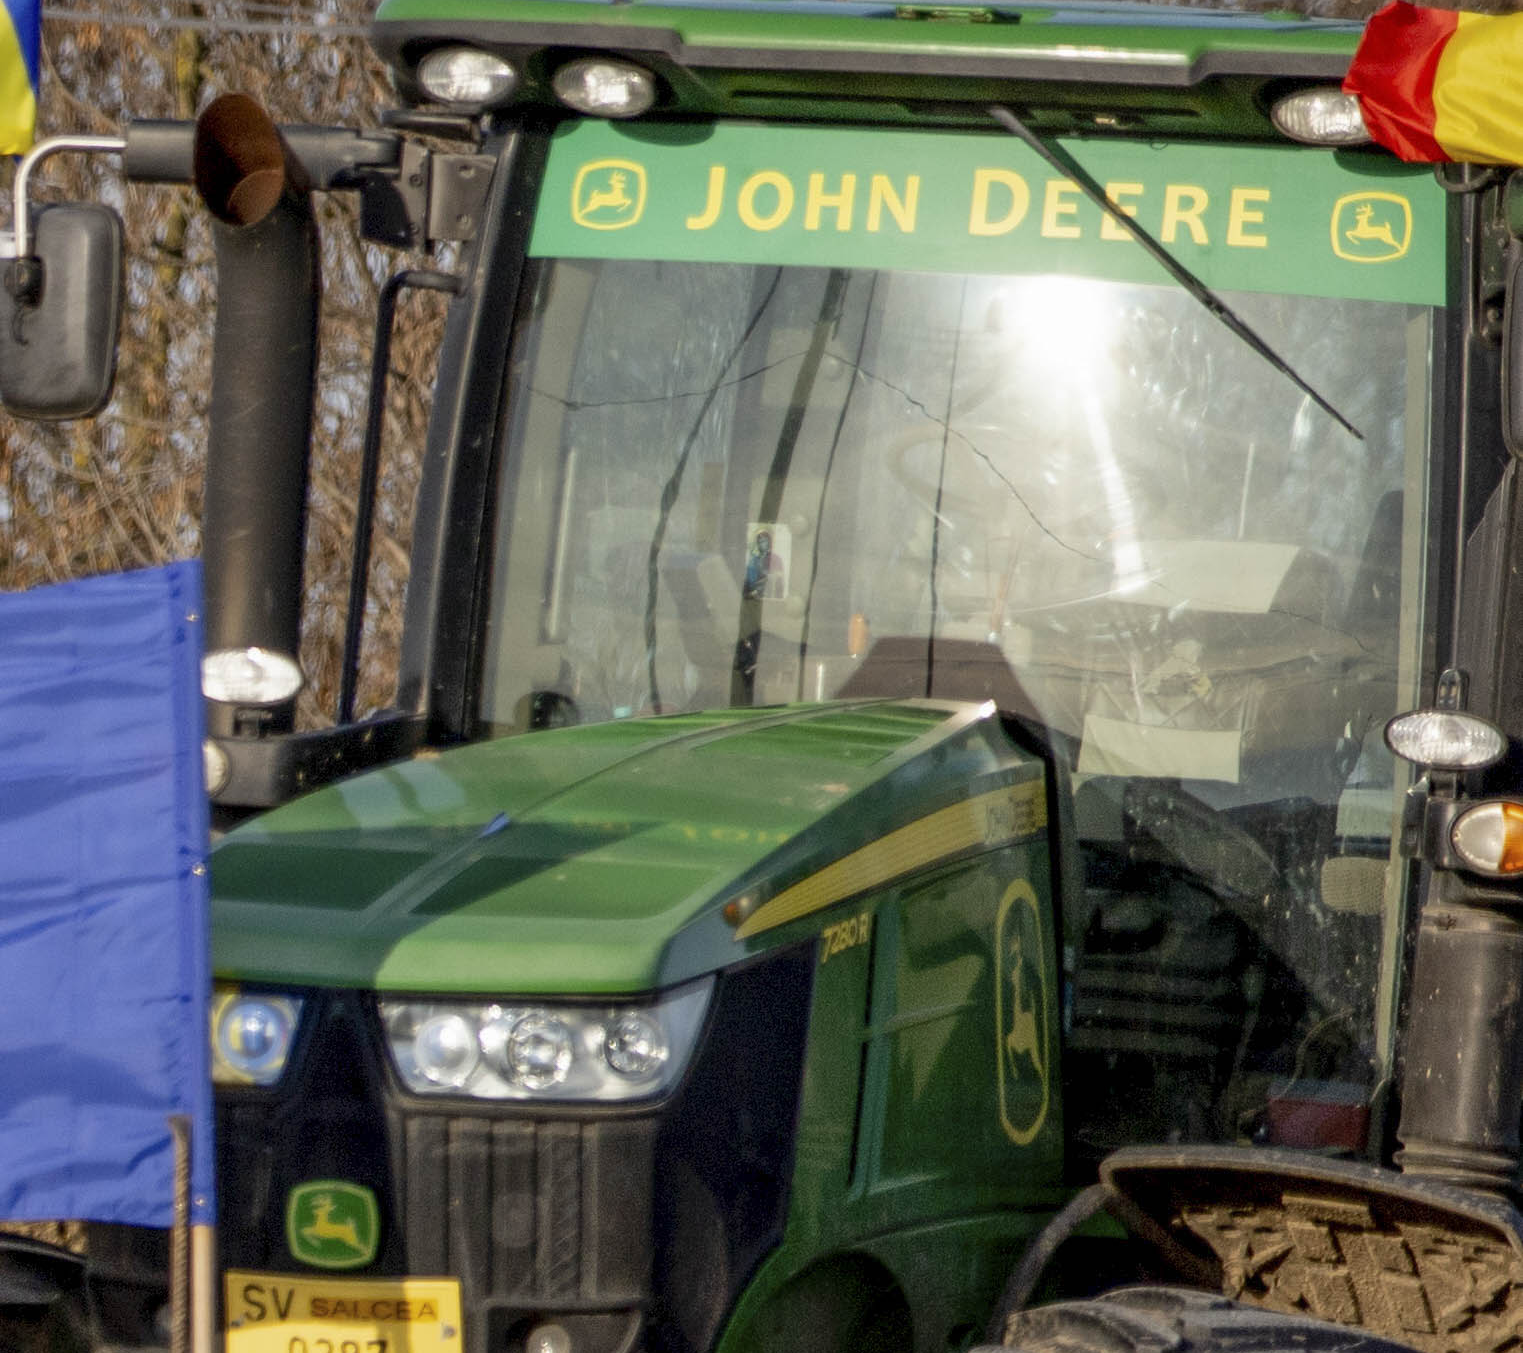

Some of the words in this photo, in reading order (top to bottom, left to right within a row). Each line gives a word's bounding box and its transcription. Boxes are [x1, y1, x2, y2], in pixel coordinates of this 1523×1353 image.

[684, 164, 922, 234] JOHN
[967, 166, 1271, 249] DEERE
[242, 1283, 295, 1322] SV
[308, 1297, 437, 1322] SALCEA
